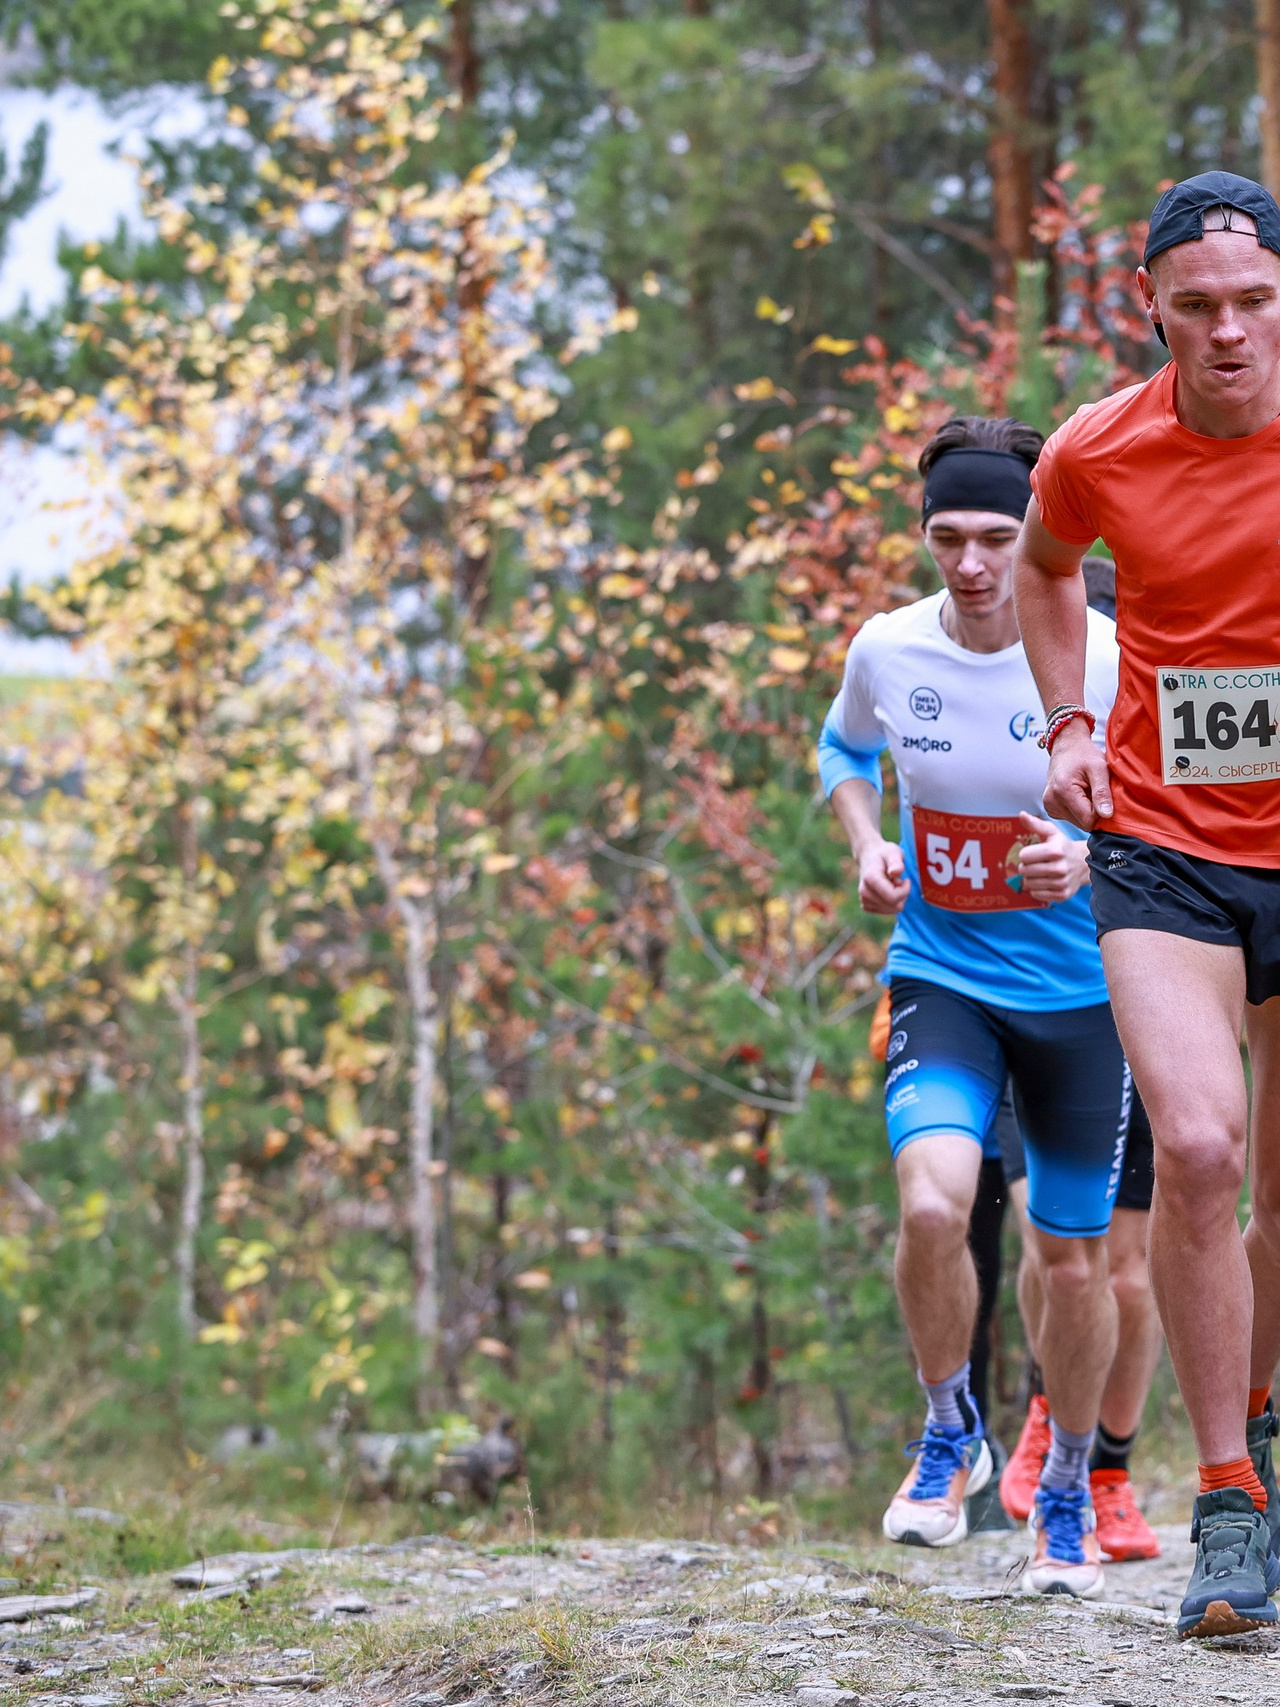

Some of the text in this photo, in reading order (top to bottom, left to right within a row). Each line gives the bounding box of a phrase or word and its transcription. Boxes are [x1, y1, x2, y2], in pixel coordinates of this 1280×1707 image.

[1162, 673, 1207, 689] TRA
[1173, 699, 1276, 750] 164
[926, 832, 989, 890] 54
[1104, 1135, 1126, 1201] TEAM
